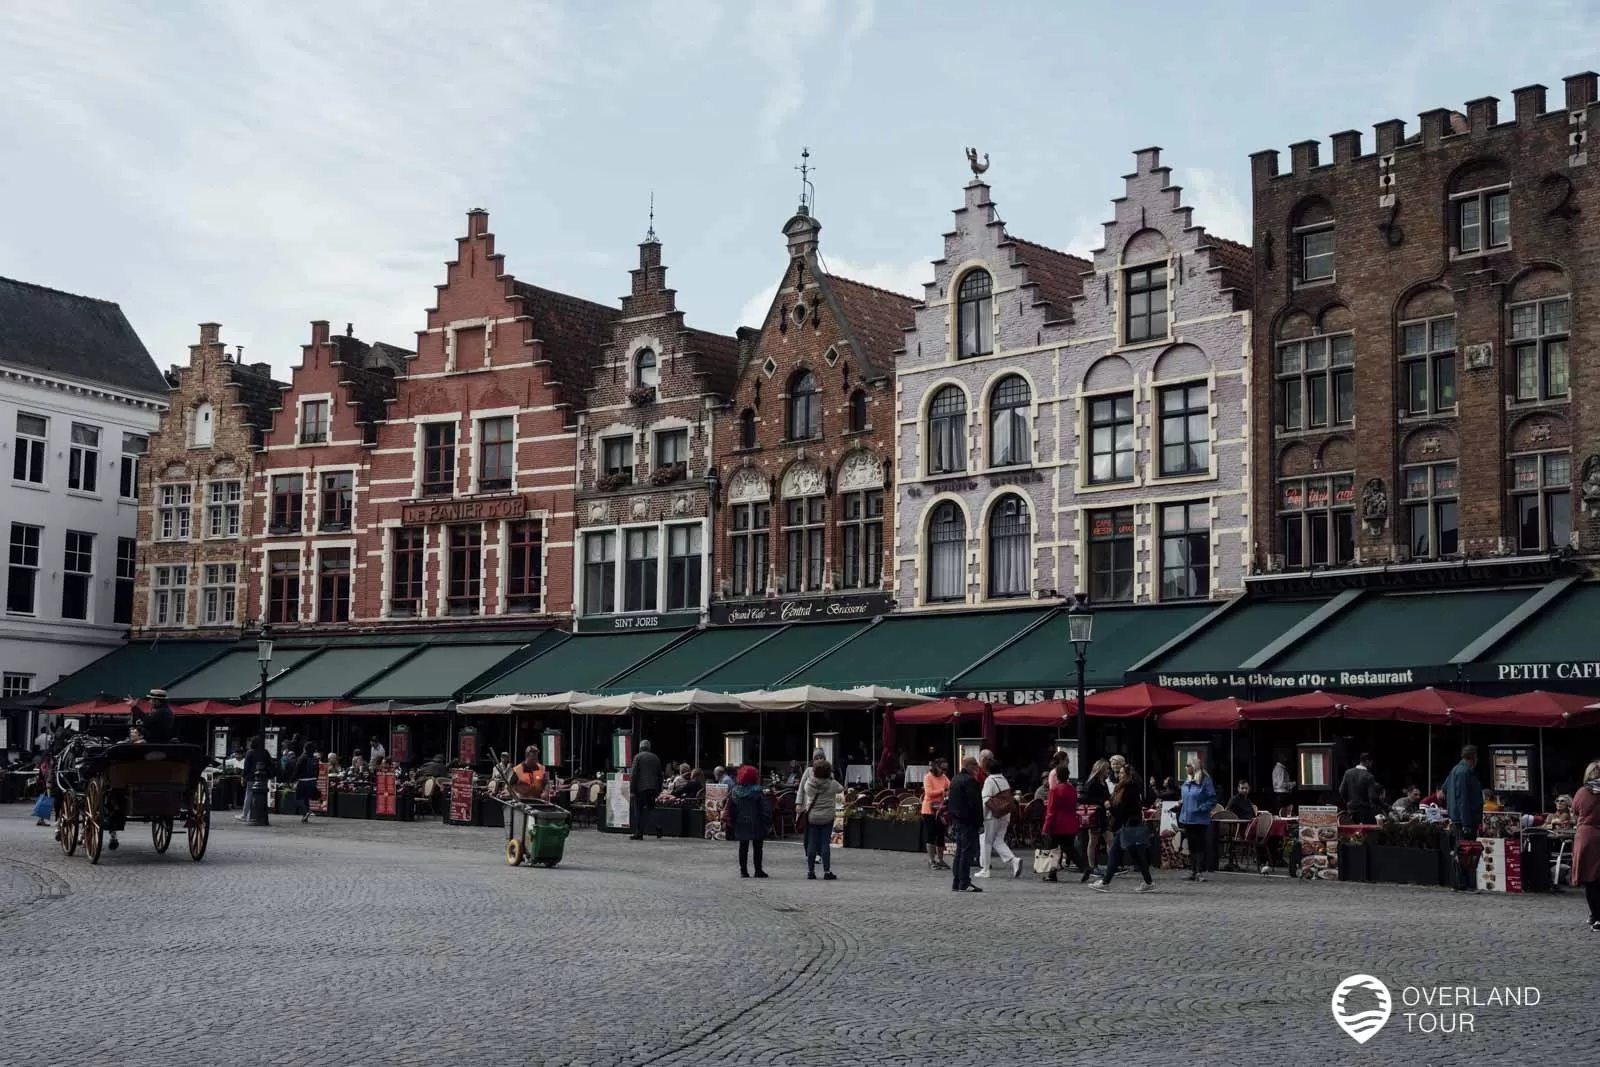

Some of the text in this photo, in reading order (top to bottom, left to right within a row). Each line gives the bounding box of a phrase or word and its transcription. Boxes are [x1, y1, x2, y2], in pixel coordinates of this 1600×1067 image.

[409, 509, 425, 522] LE
[429, 503, 482, 521] PANIER
[728, 609, 750, 623] Grand
[781, 601, 812, 620] Central
[826, 604, 869, 615] Brasserie
[614, 616, 658, 628] SINT JORIS
[1158, 674, 1218, 686] Brasserie
[1229, 675, 1246, 686] La
[1298, 674, 1327, 686] d'Or
[1340, 669, 1413, 685] Restaurant
[1497, 663, 1551, 680] PETIT
[914, 686, 936, 695] pasta
[1013, 690, 1044, 705] DES
